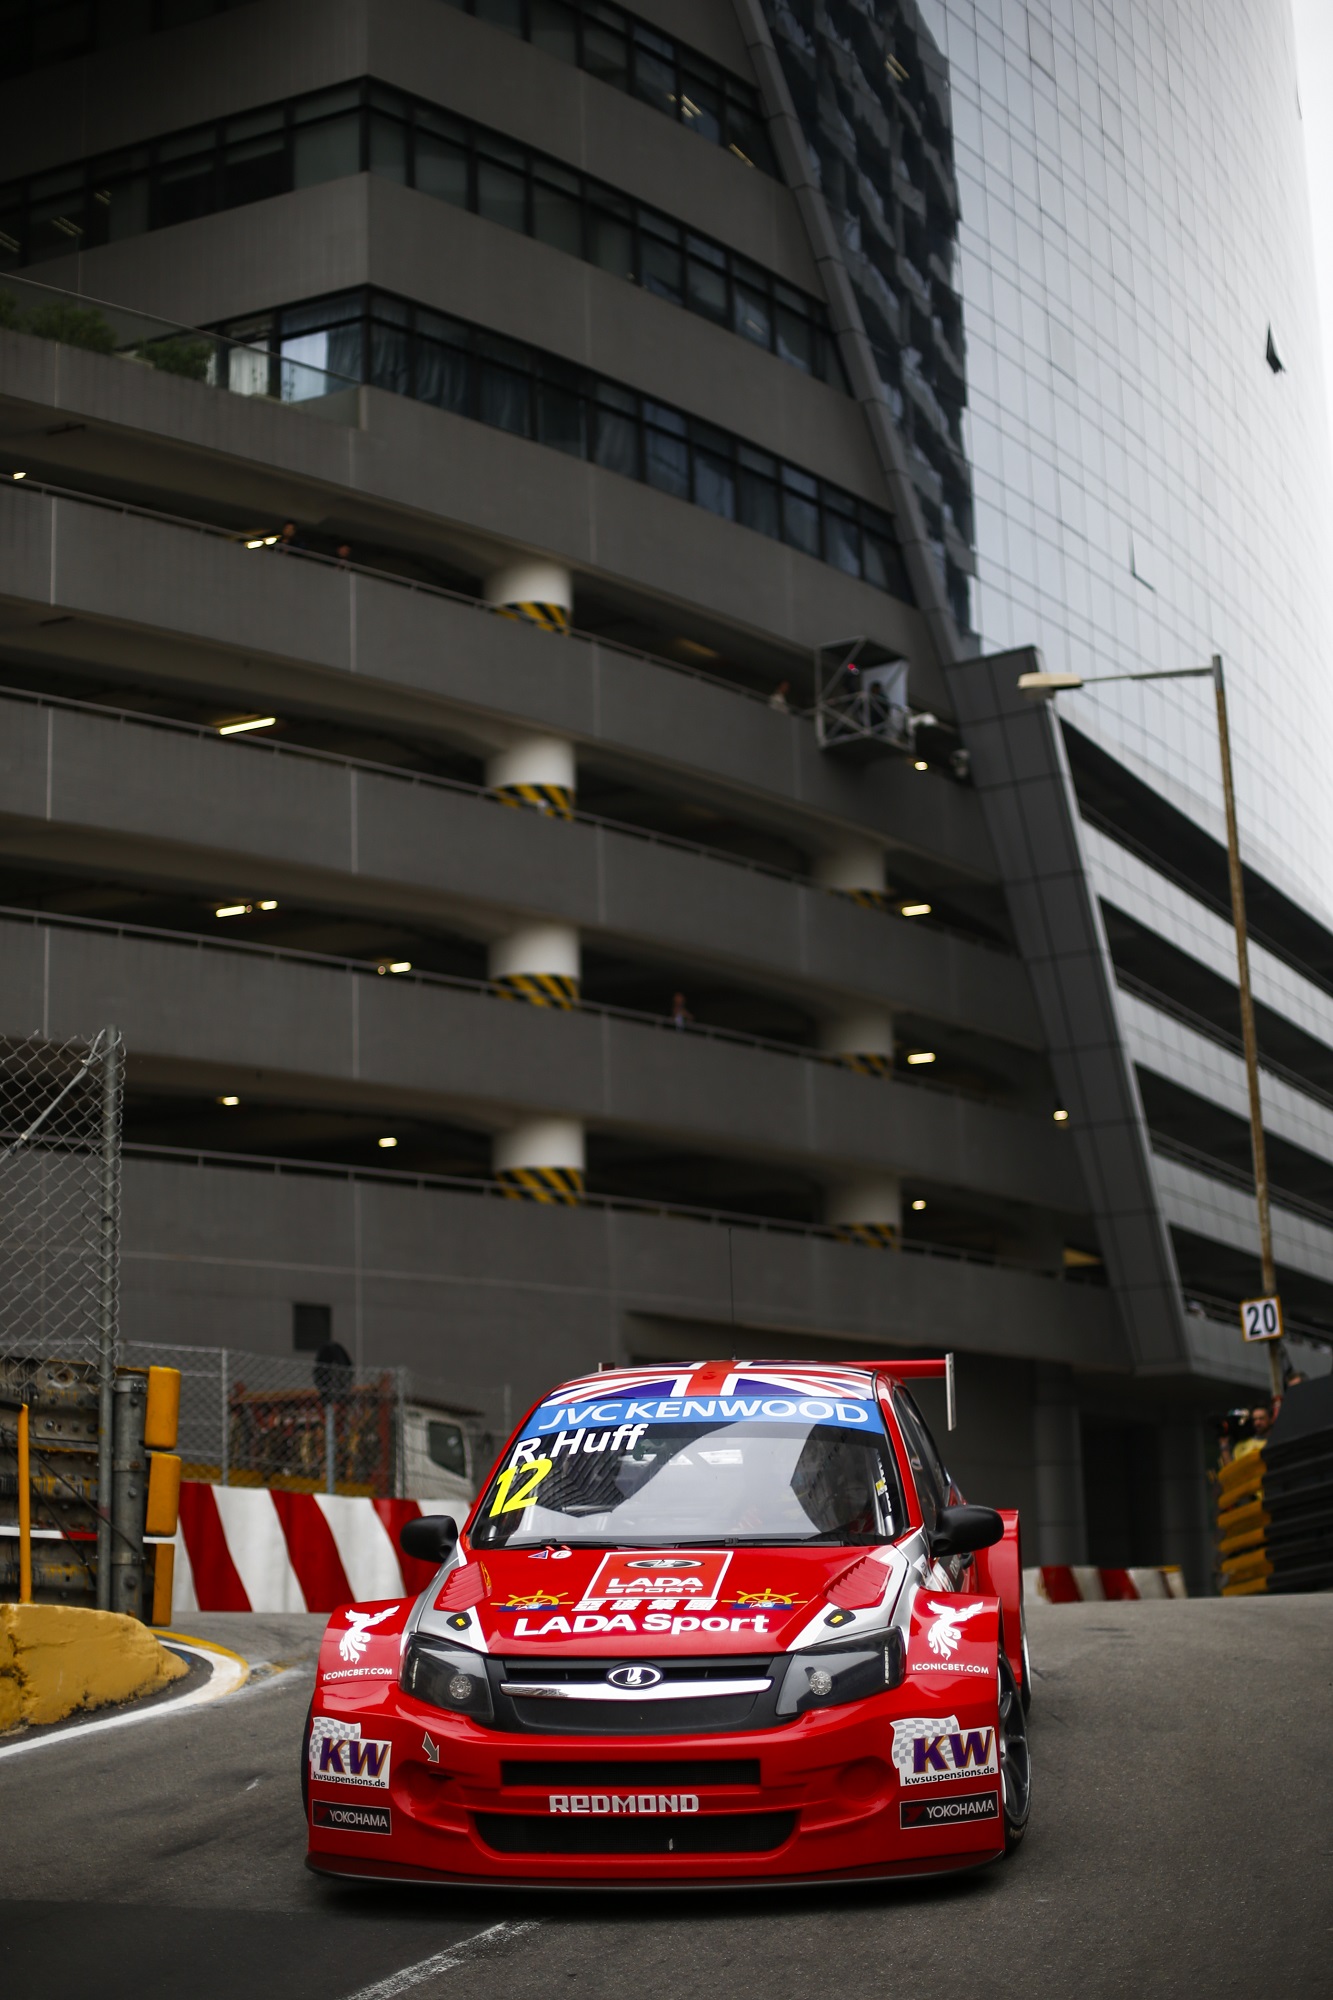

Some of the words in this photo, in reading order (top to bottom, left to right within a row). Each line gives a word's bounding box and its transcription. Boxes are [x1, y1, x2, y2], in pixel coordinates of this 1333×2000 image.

[1247, 1303, 1277, 1336] 20
[489, 1459, 553, 1518] 12
[608, 1577, 704, 1588] LADA
[513, 1614, 637, 1637] LADA
[641, 1613, 770, 1635] Sport
[323, 1667, 393, 1681] ICONICBET.COM
[912, 1663, 989, 1674] ICONICBET.COM
[319, 1737, 391, 1778] KW
[912, 1729, 995, 1774] KW
[313, 1771, 386, 1788] kwsuspensions.de
[904, 1766, 995, 1785] kwsuspensions.de
[329, 1809, 388, 1828] YOKOHAMA
[926, 1799, 995, 1819] YOKOHAMA
